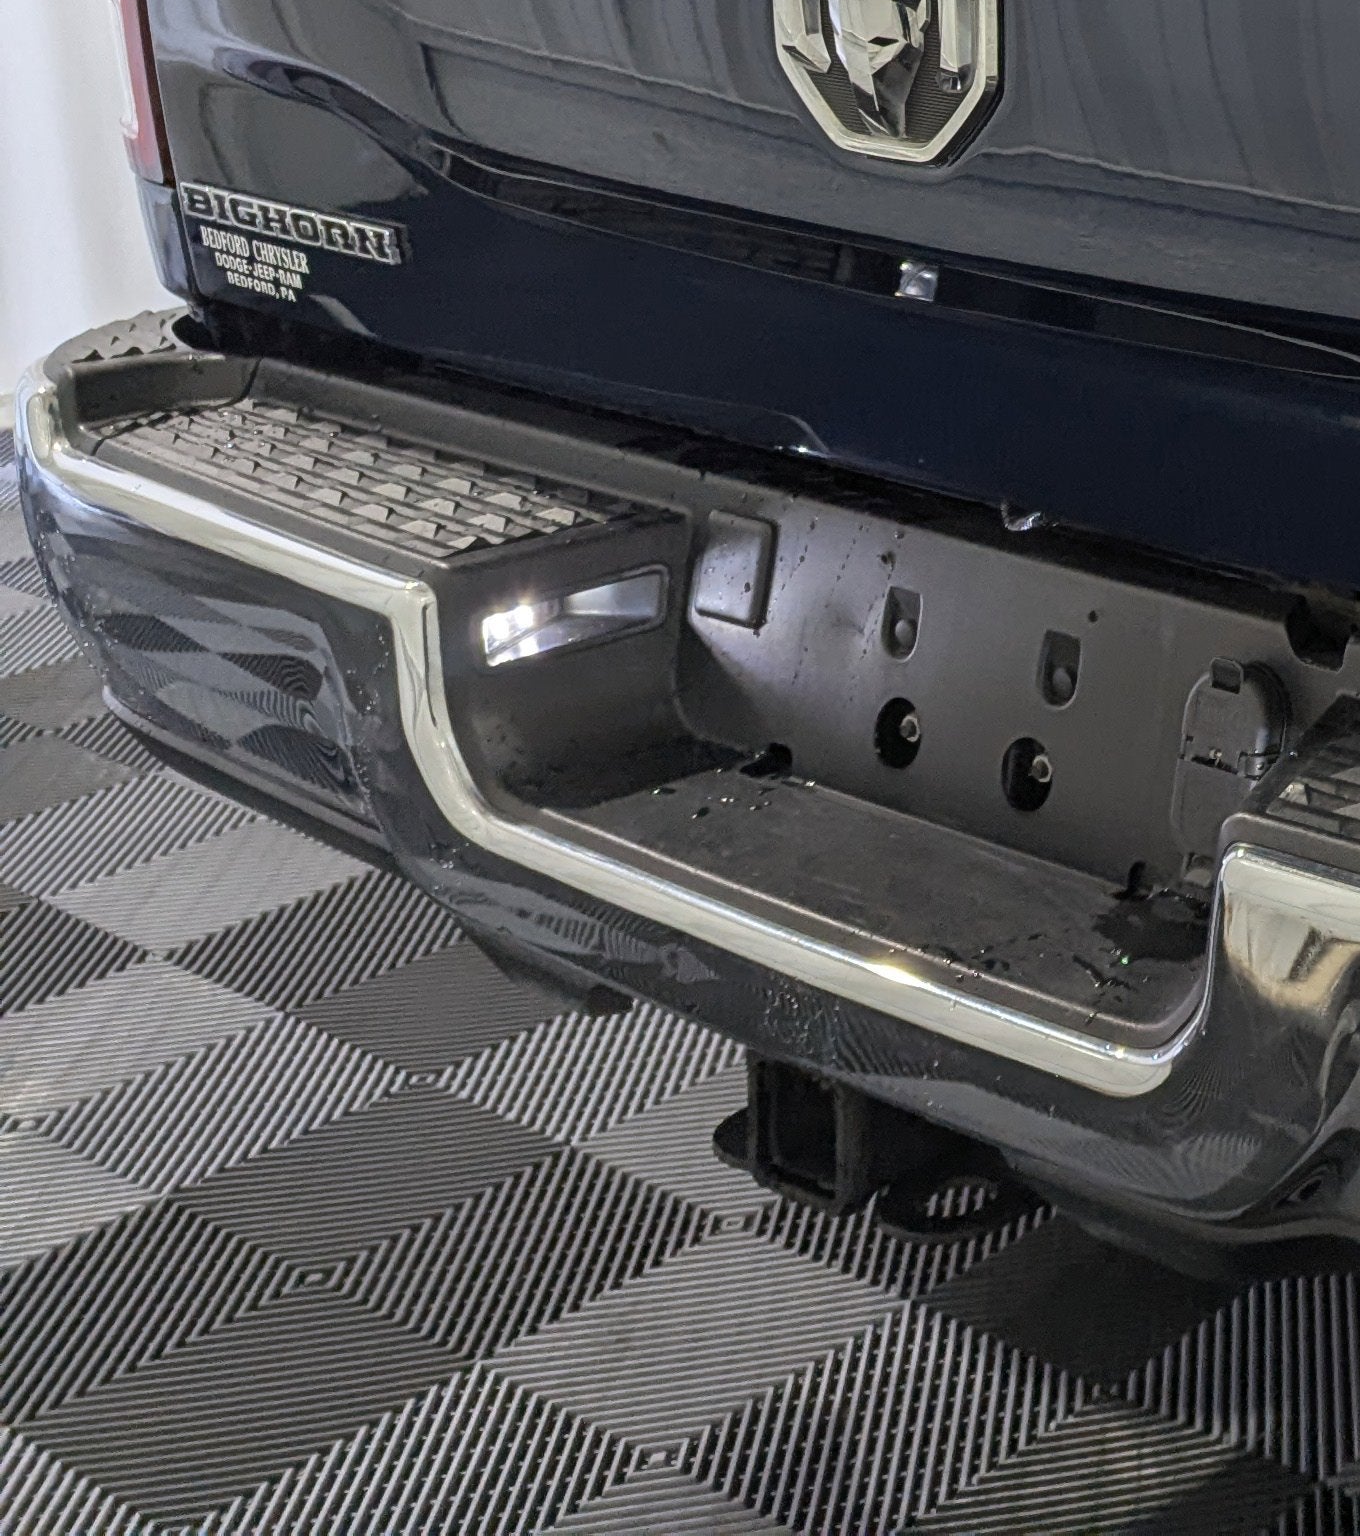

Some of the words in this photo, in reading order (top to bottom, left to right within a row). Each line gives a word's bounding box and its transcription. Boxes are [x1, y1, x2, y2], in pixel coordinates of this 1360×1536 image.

[181, 183, 400, 264] BIGHORN
[200, 225, 250, 258] BEDFORD
[252, 240, 310, 274] CHRYSLER
[226, 271, 280, 300] BEDFORD,
[279, 287, 297, 303] PA
